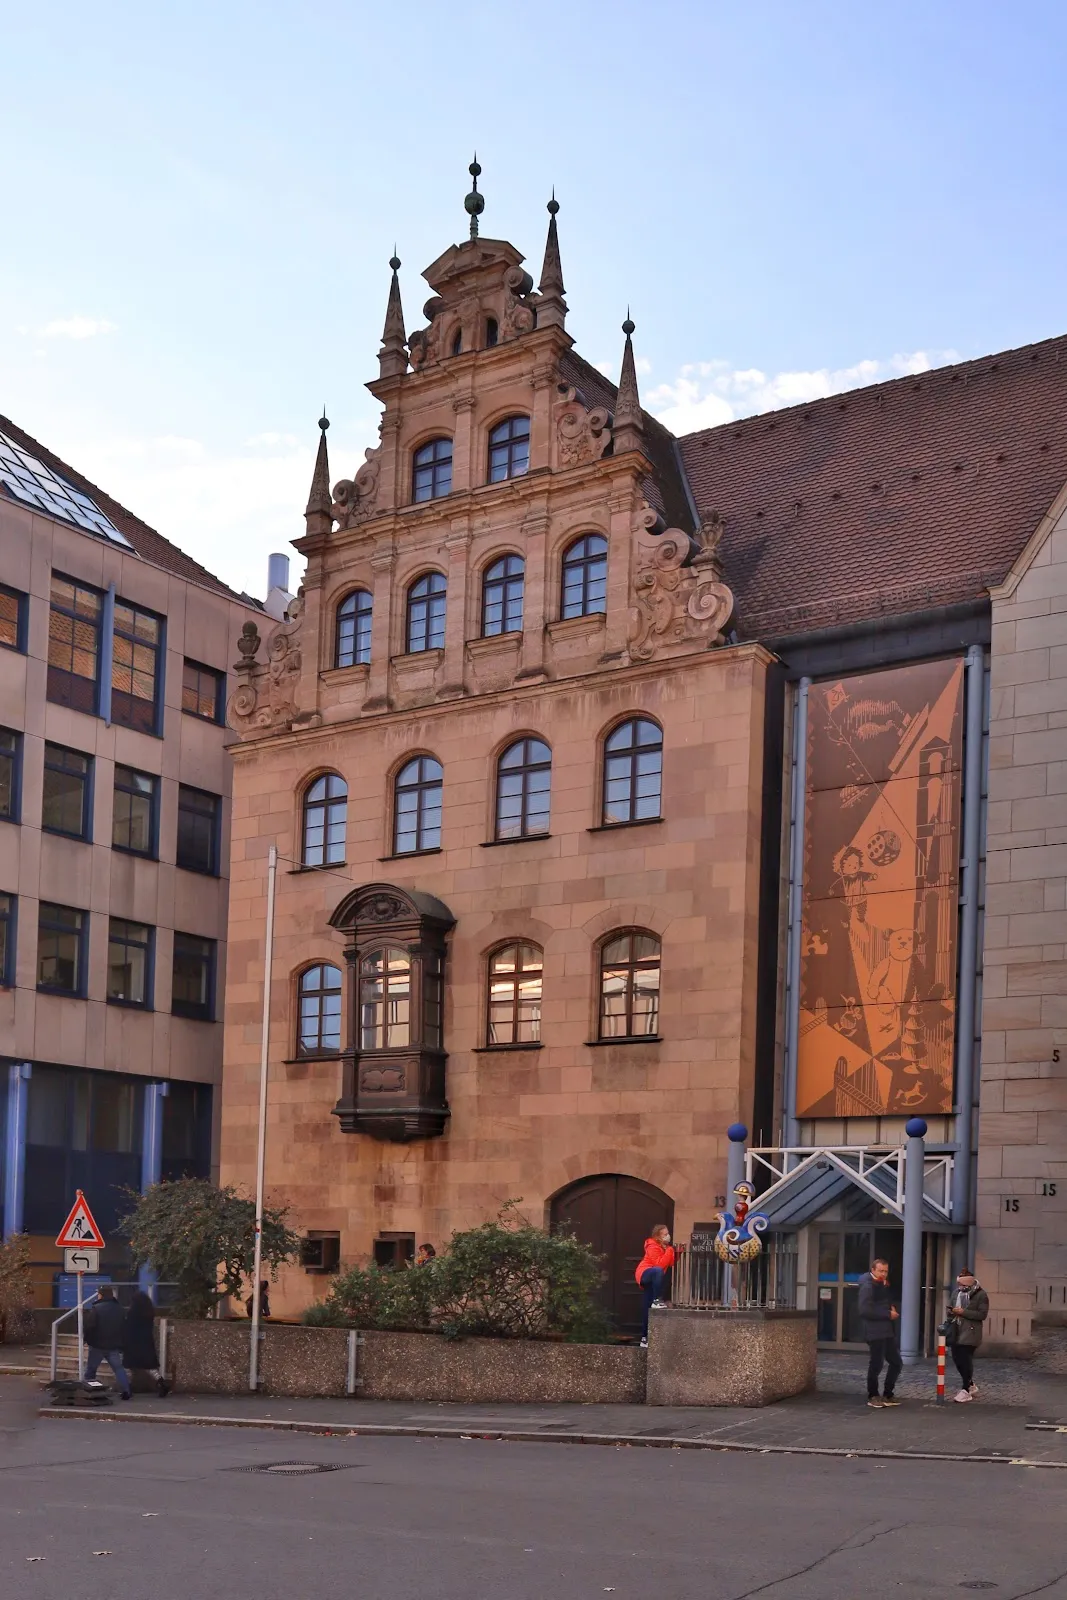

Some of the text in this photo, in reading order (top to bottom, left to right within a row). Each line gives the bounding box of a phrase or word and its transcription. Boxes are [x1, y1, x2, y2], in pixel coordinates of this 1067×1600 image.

[1052, 1049, 1060, 1063] 5
[1042, 1183, 1057, 1197] 15
[714, 1195, 727, 1208] 13
[1005, 1199, 1020, 1212] 15
